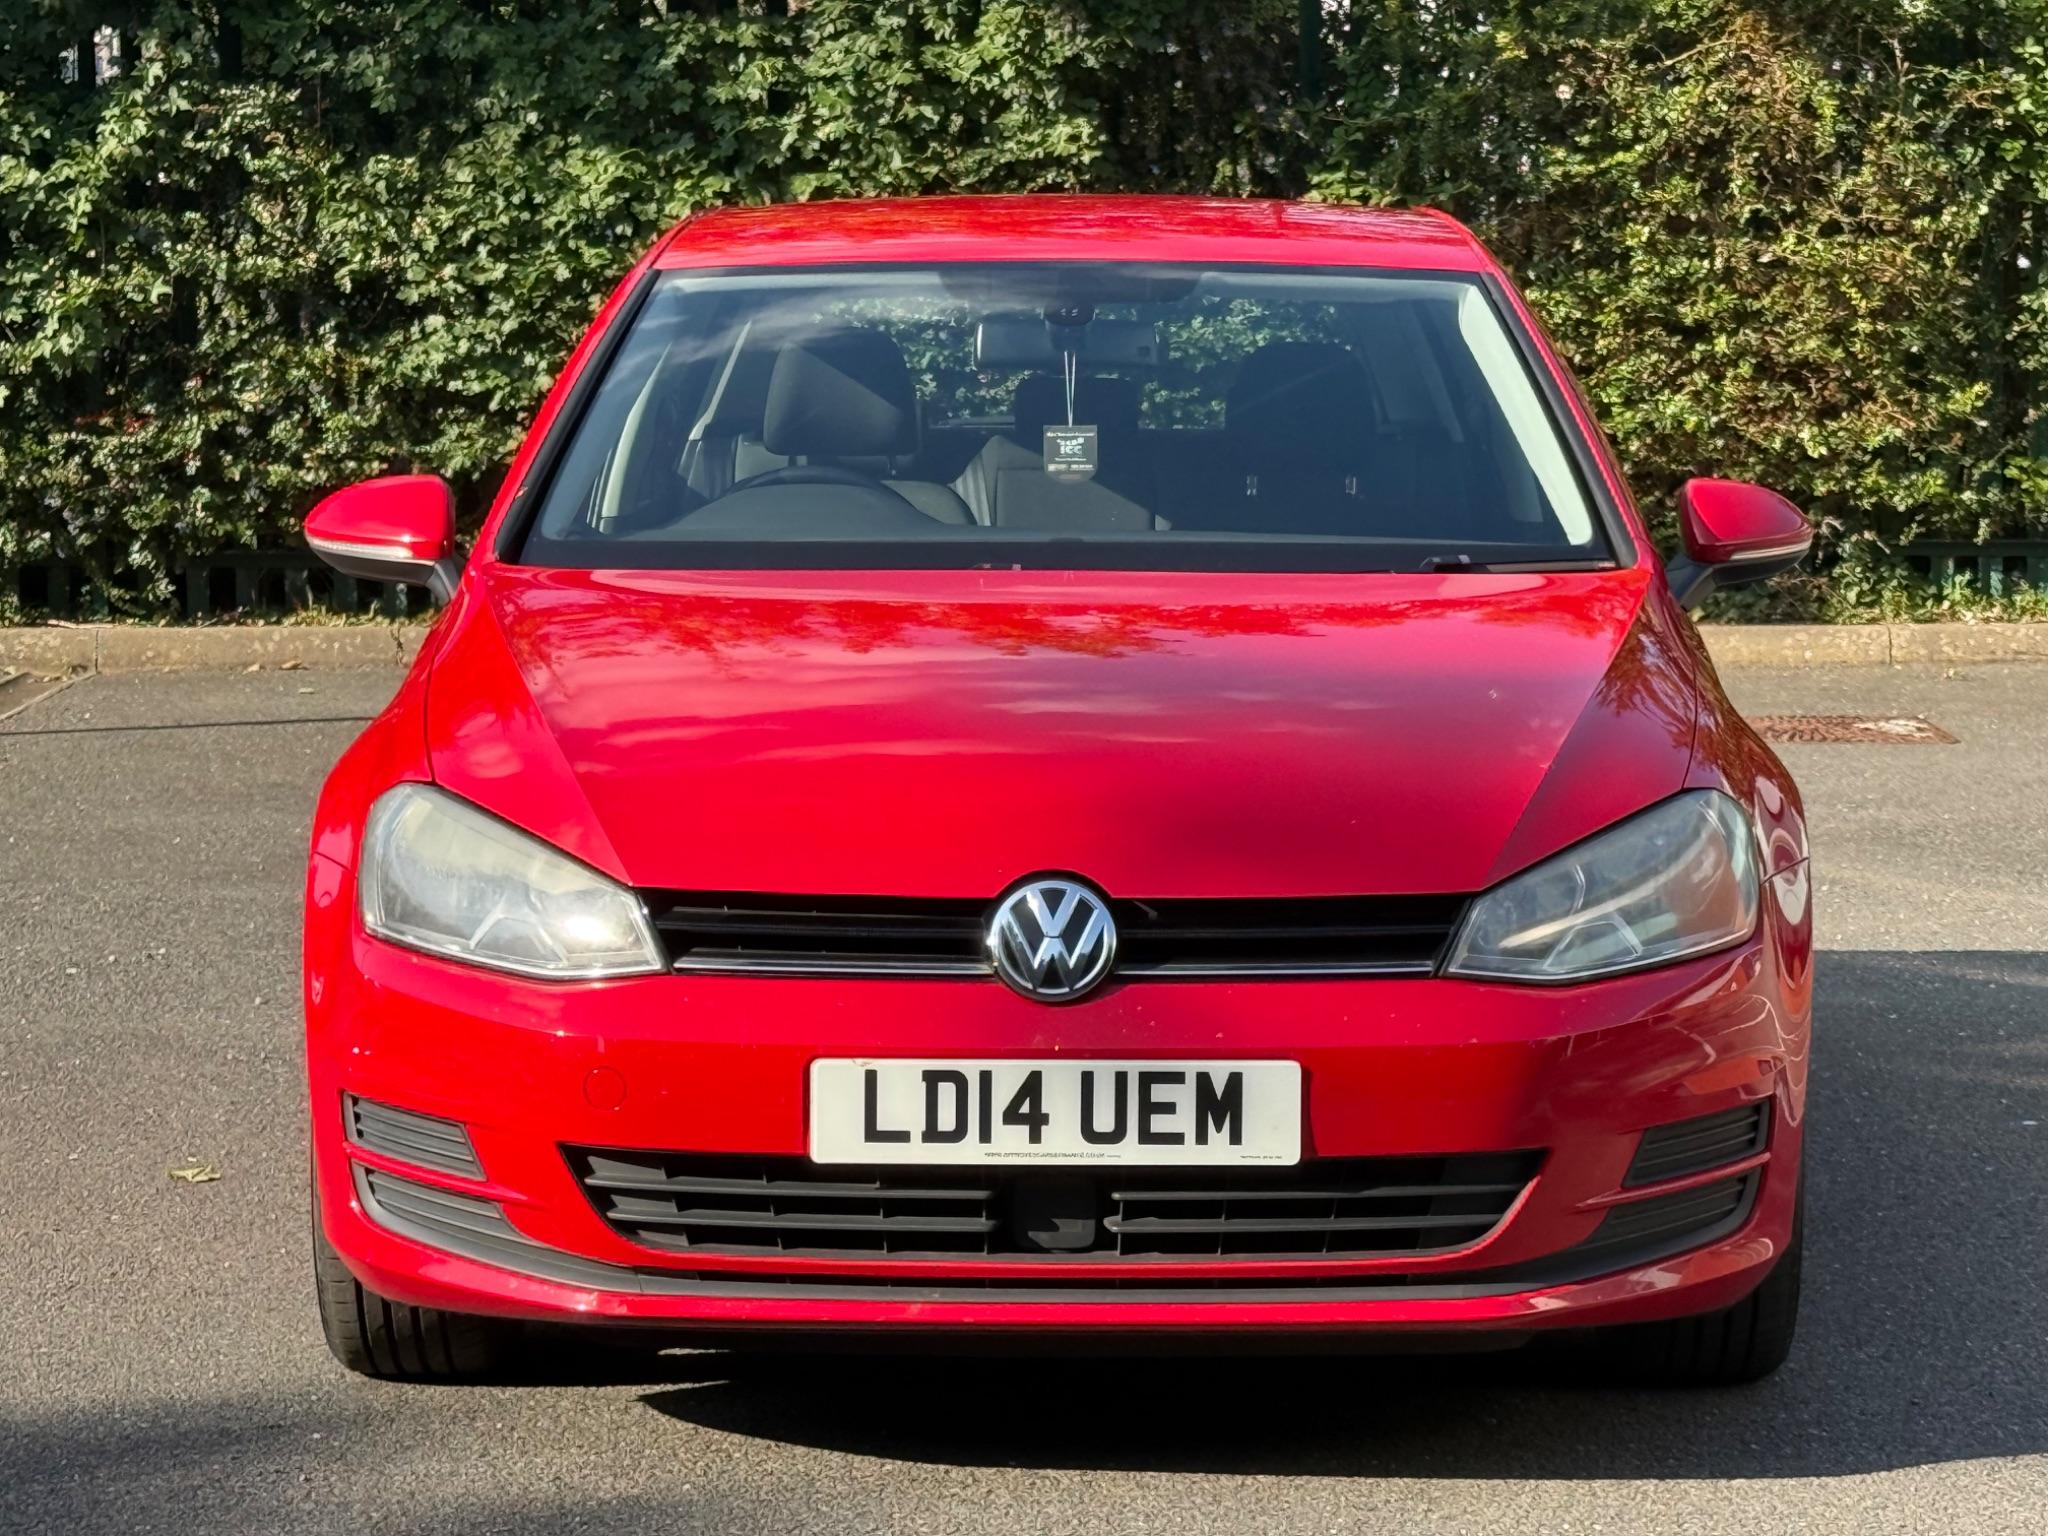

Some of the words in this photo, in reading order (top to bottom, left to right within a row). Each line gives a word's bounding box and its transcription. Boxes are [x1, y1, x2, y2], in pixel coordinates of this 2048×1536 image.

[994, 882, 1114, 995] VW
[864, 1069, 1050, 1145] LD14
[1080, 1070, 1243, 1146] UEM
